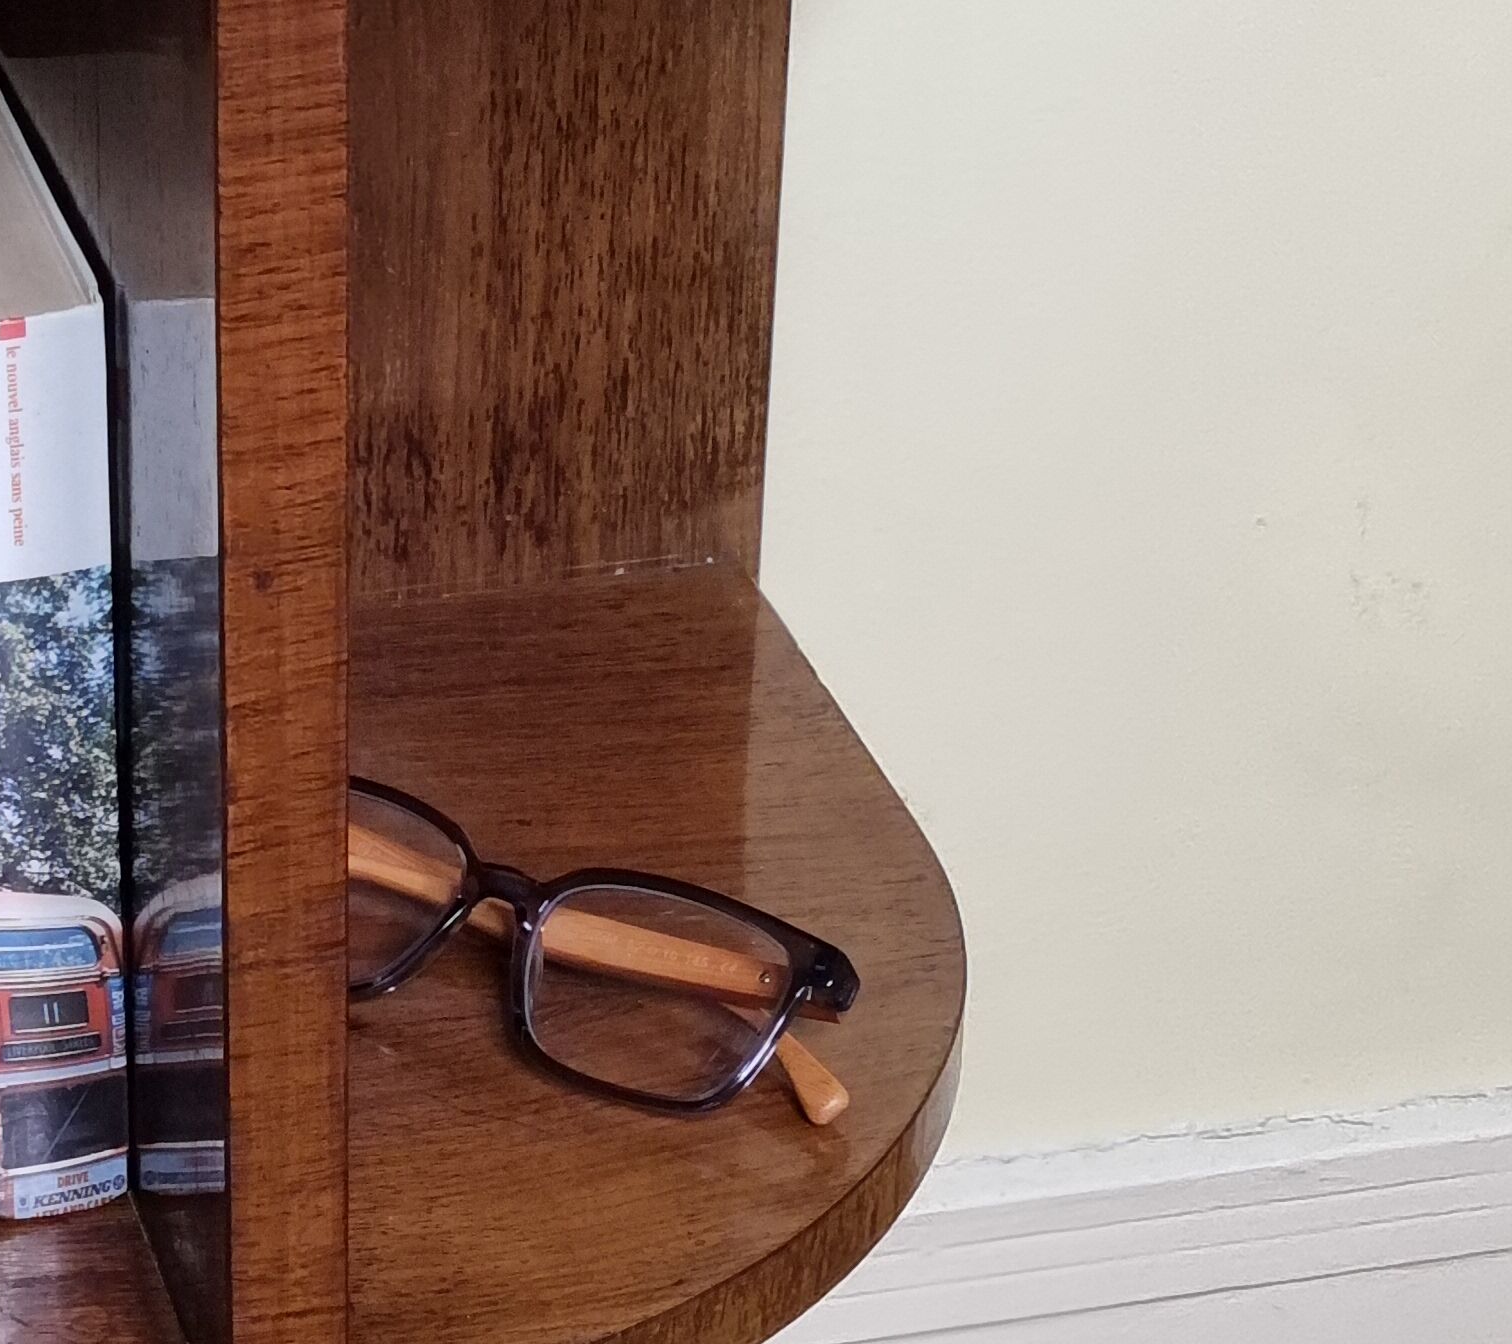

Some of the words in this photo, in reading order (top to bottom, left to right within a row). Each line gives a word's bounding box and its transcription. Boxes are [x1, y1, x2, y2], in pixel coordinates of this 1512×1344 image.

[5, 345, 22, 359] le
[5, 363, 24, 413] nouvel
[5, 418, 25, 469] anglais
[10, 472, 23, 503] sans
[8, 507, 28, 547] peine
[43, 1002, 60, 1025] 11
[32, 1179, 112, 1209] KENNING
[57, 1171, 89, 1188] DRIVE
